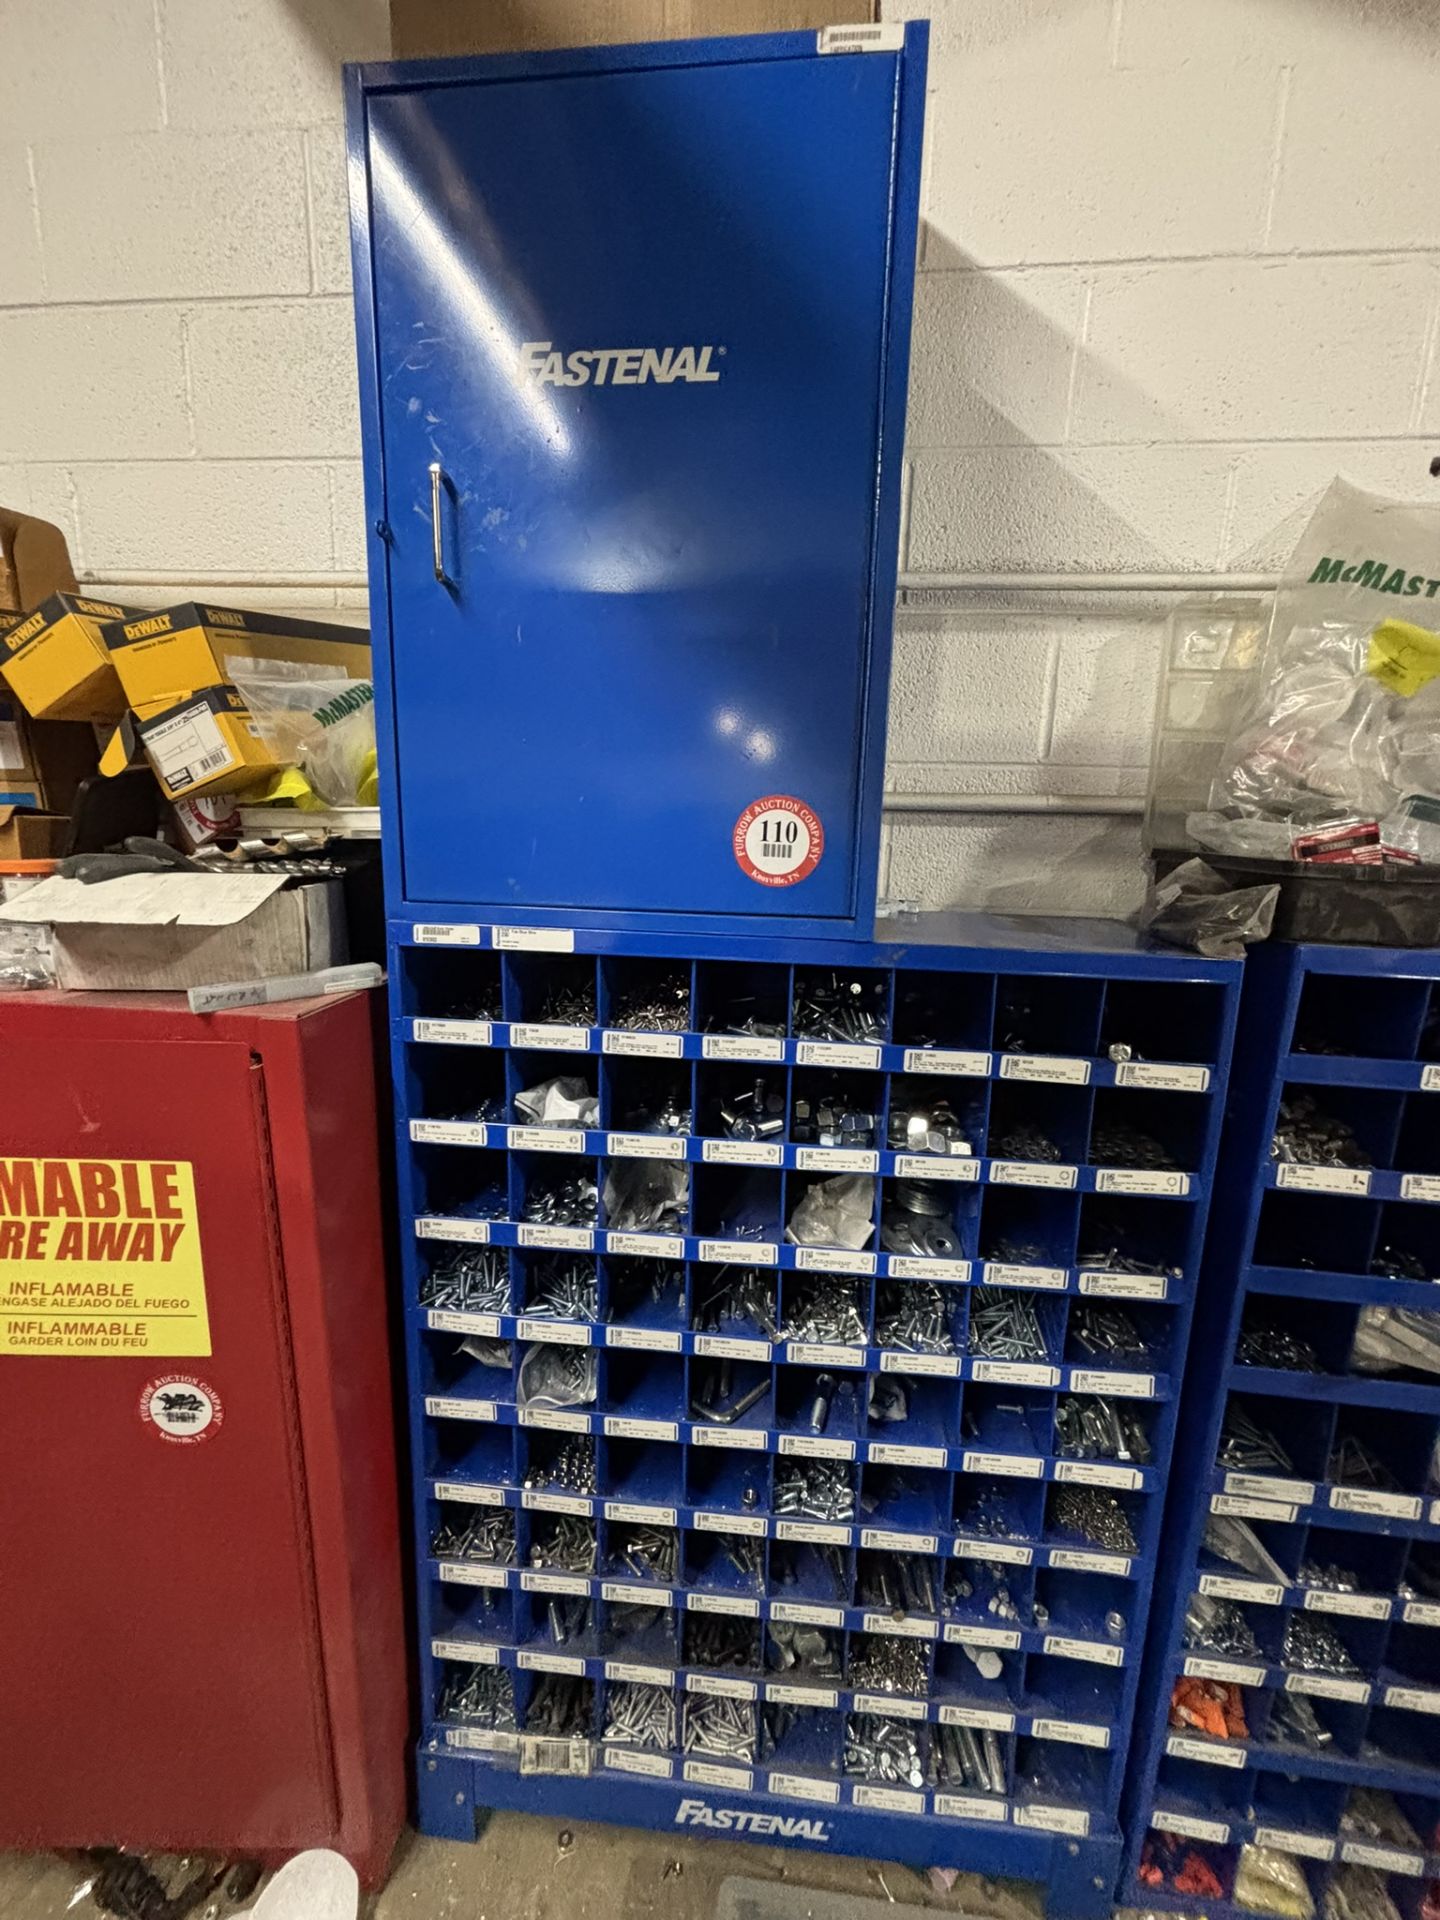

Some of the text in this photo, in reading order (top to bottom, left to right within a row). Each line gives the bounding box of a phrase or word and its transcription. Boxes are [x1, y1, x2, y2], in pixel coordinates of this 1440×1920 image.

[734, 799, 822, 863] FURROW AUCTION COMPANY
[760, 820, 799, 844] 110
[0, 1161, 183, 1220] MABLE
[0, 1220, 186, 1263] RE AWAY
[9, 1281, 134, 1297] INFLAMABLE
[0, 1297, 190, 1309] NGASE ALEJADO DEL FUEGO
[7, 1321, 147, 1336] INFLAMMABLE
[8, 1336, 148, 1348] GARDER LOIN DU FEU
[154, 1374, 200, 1388] AUCTION
[674, 1799, 830, 1842] FASTENAL
